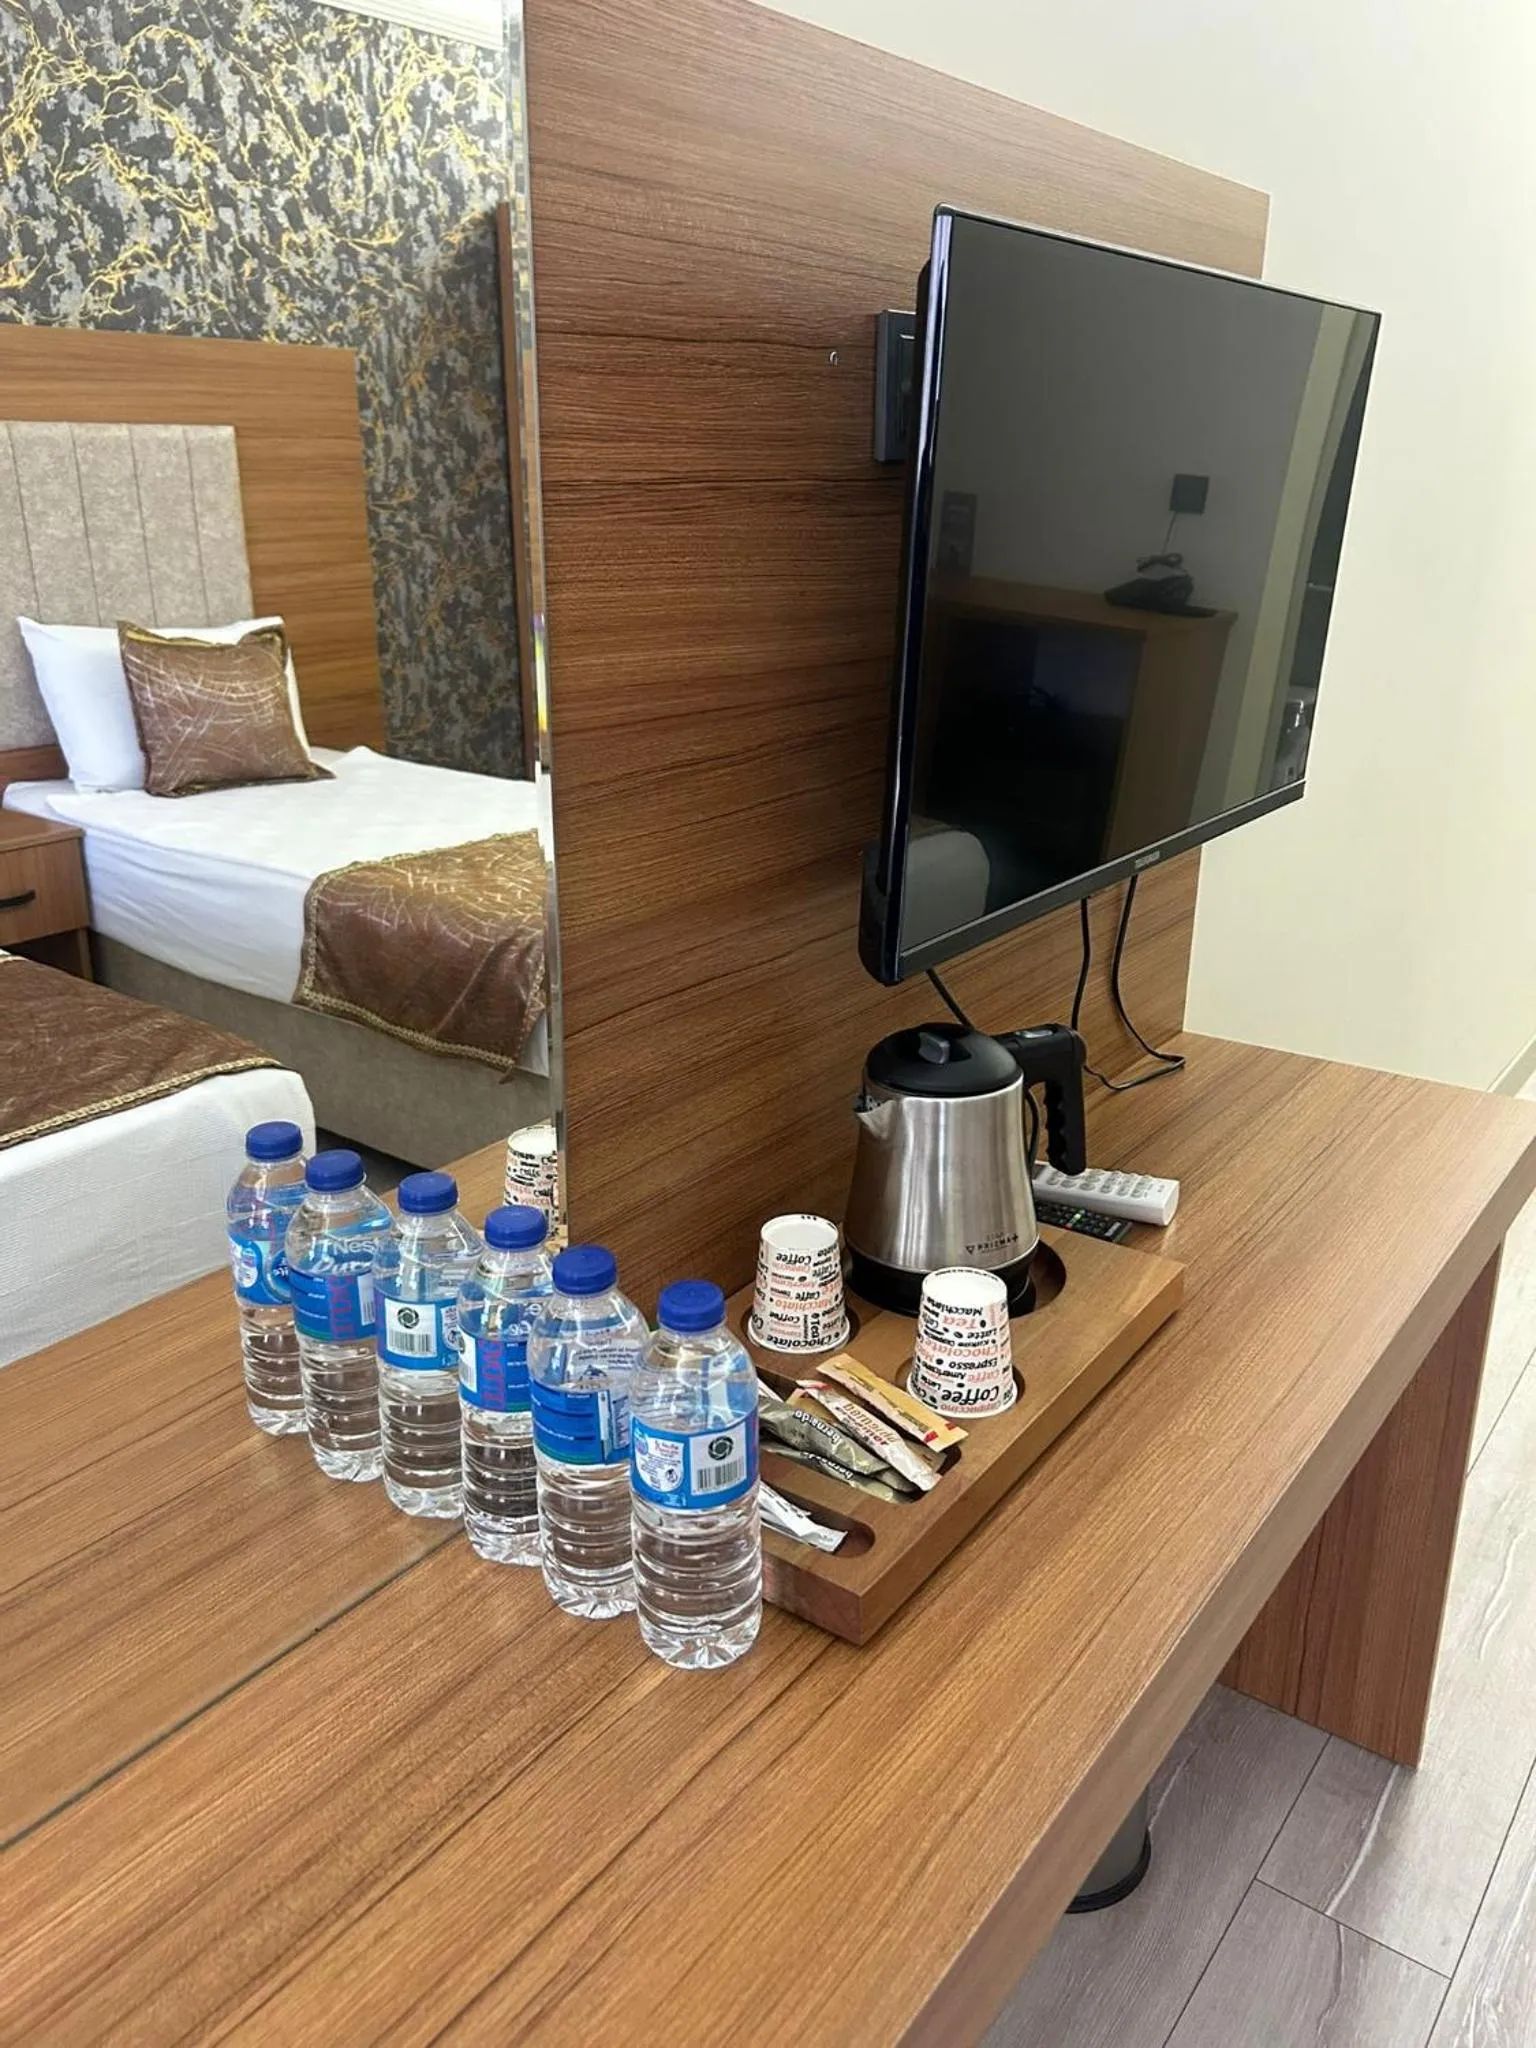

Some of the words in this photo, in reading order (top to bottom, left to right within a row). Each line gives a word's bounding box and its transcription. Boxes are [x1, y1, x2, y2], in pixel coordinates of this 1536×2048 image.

[776, 1252, 812, 1266] Coffee
[927, 1296, 984, 1316] Macchiato
[943, 1315, 977, 1329] Tea
[766, 1334, 833, 1347] Chocolate
[967, 1328, 998, 1340] Latte
[925, 1338, 999, 1357] Chocolate
[949, 1357, 998, 1371] Espresso
[967, 1368, 1000, 1383] Caffe
[941, 1385, 1000, 1406] Coffee
